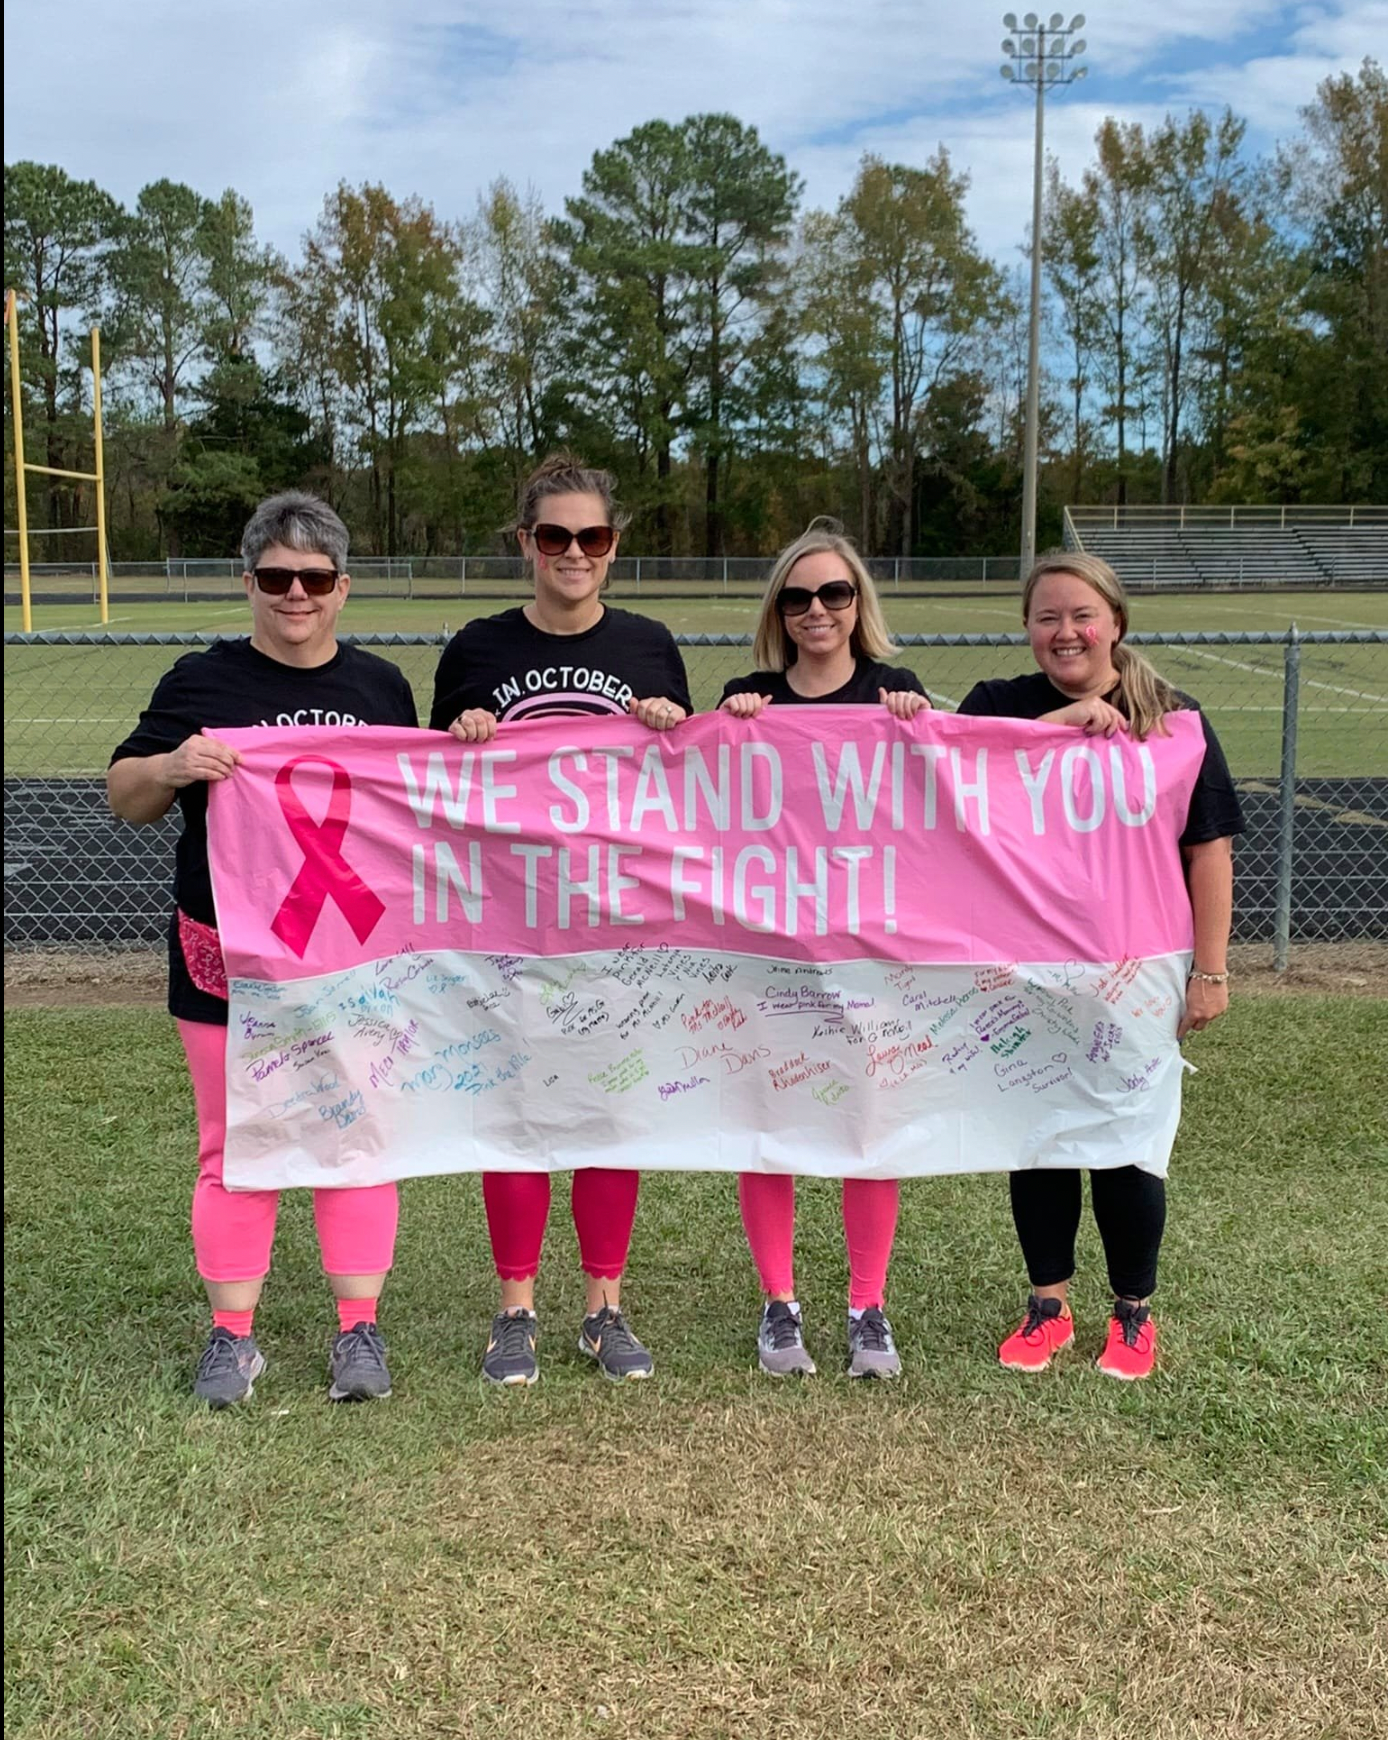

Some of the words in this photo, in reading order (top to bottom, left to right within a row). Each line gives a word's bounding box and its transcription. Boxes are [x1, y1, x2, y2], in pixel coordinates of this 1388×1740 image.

[525, 666, 633, 712] OCTOBER
[397, 750, 521, 834] WE
[548, 742, 783, 833] STAND
[811, 741, 990, 836] WITH
[1014, 746, 1156, 836] YOU
[412, 841, 484, 925] IN
[510, 843, 645, 930] THE
[671, 844, 897, 937] FIGHT!
[757, 1001, 768, 1011] I
[772, 1001, 796, 1010] wear
[765, 985, 799, 1005] Cindy
[801, 985, 842, 1000] Barrow
[915, 995, 957, 1012] Mitchell
[674, 1042, 734, 1071] Diane
[720, 1044, 771, 1075] Davis
[993, 1059, 1028, 1078] Gina
[997, 1063, 1055, 1092] Langston
